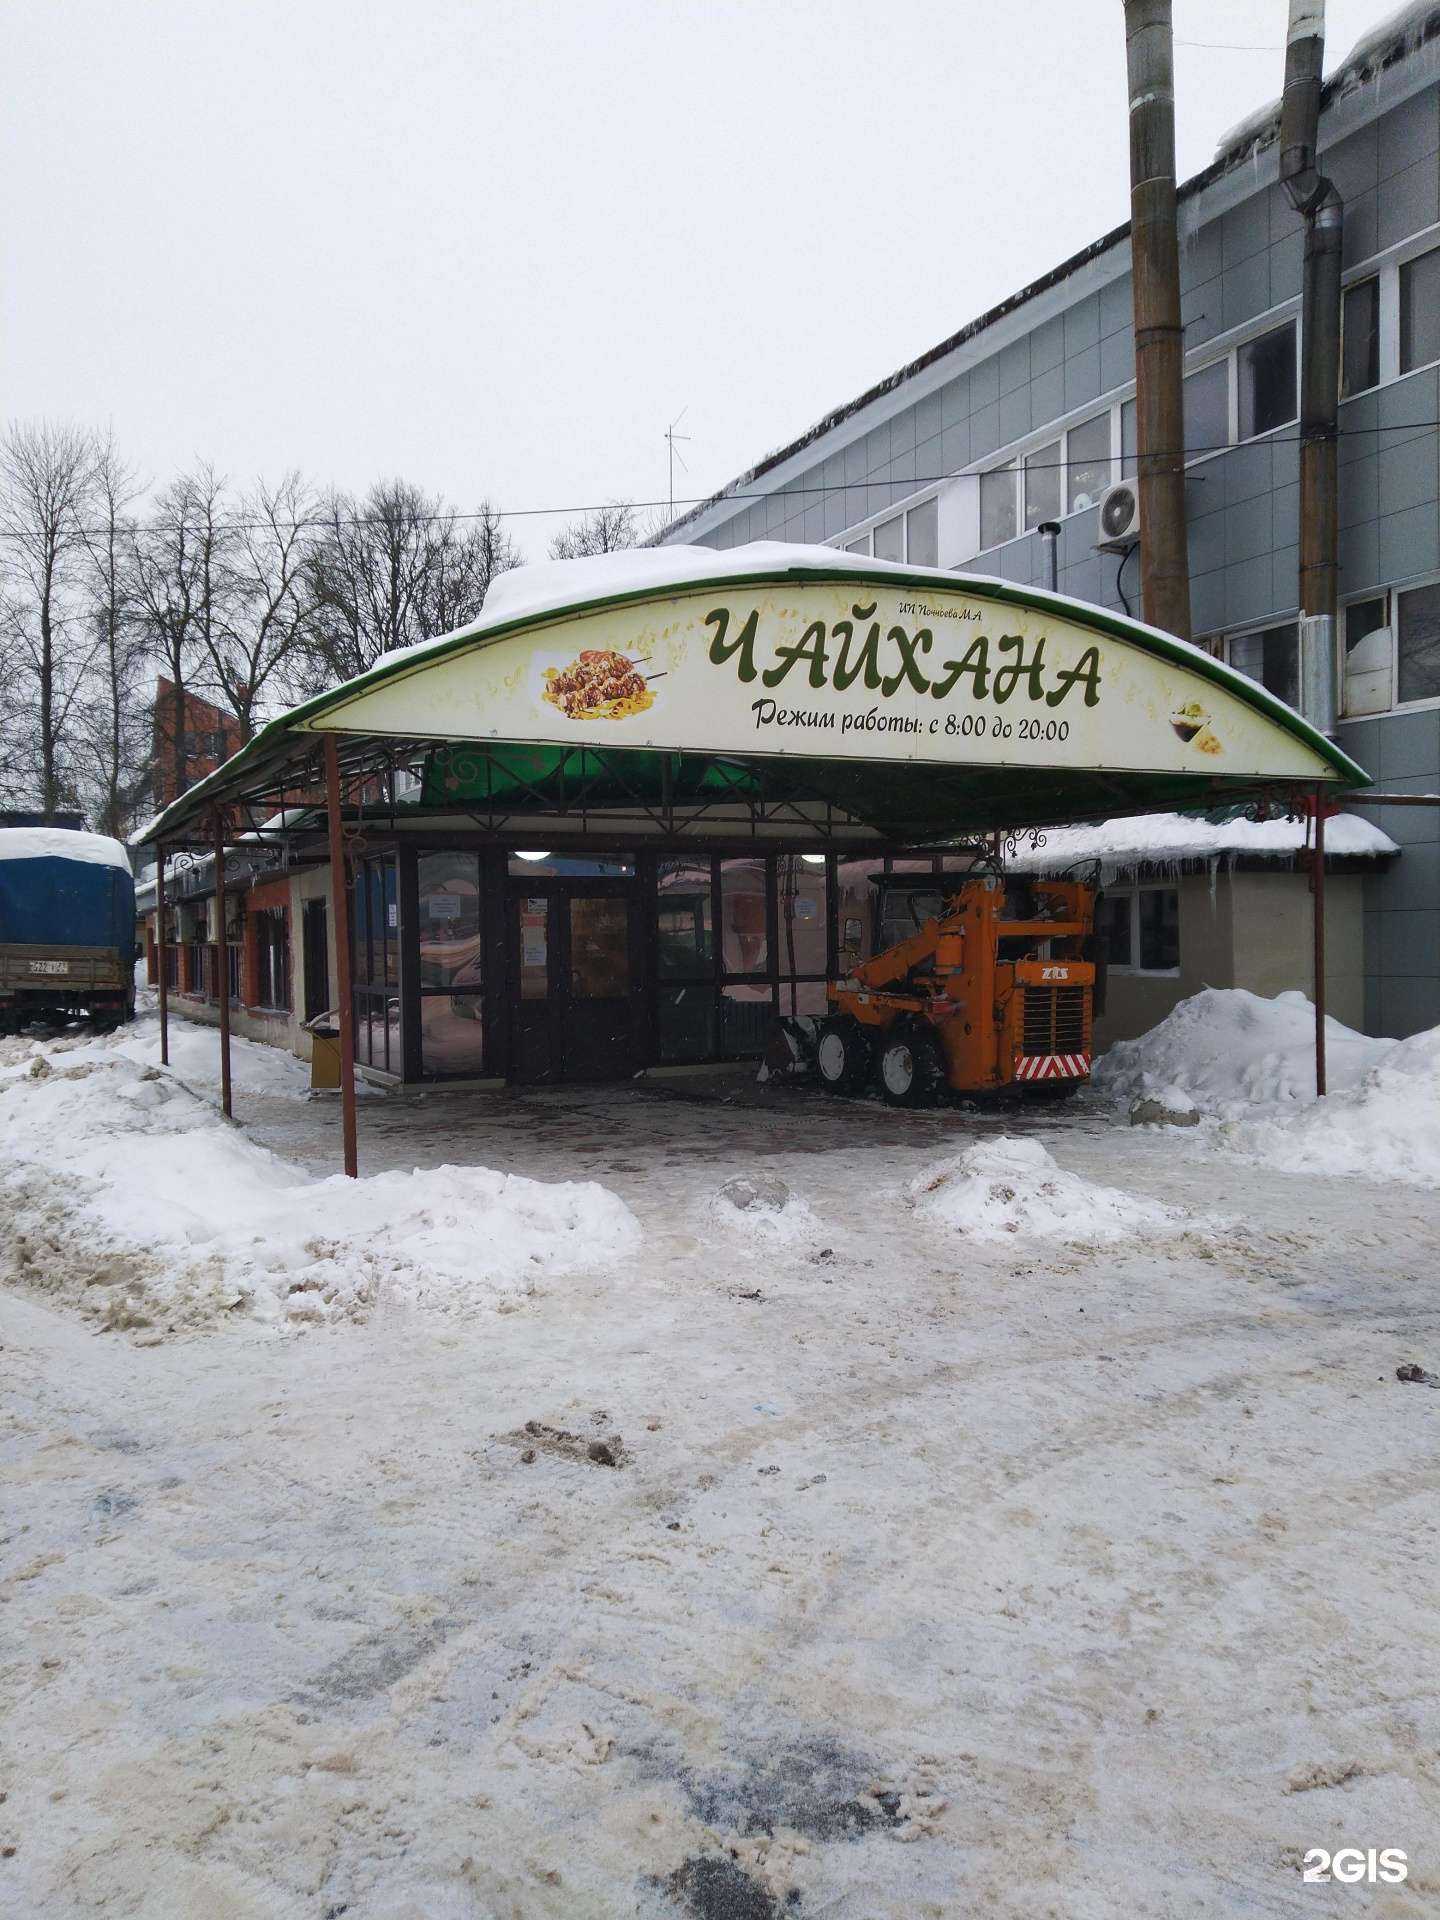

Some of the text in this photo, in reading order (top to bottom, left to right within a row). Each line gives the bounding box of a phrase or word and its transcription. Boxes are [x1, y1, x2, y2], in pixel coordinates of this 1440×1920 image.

[898, 601, 916, 615] ИП
[704, 601, 1102, 708] ЧАЙХАНА
[751, 698, 1070, 742] Режим работы: с 8:00 до 20:00
